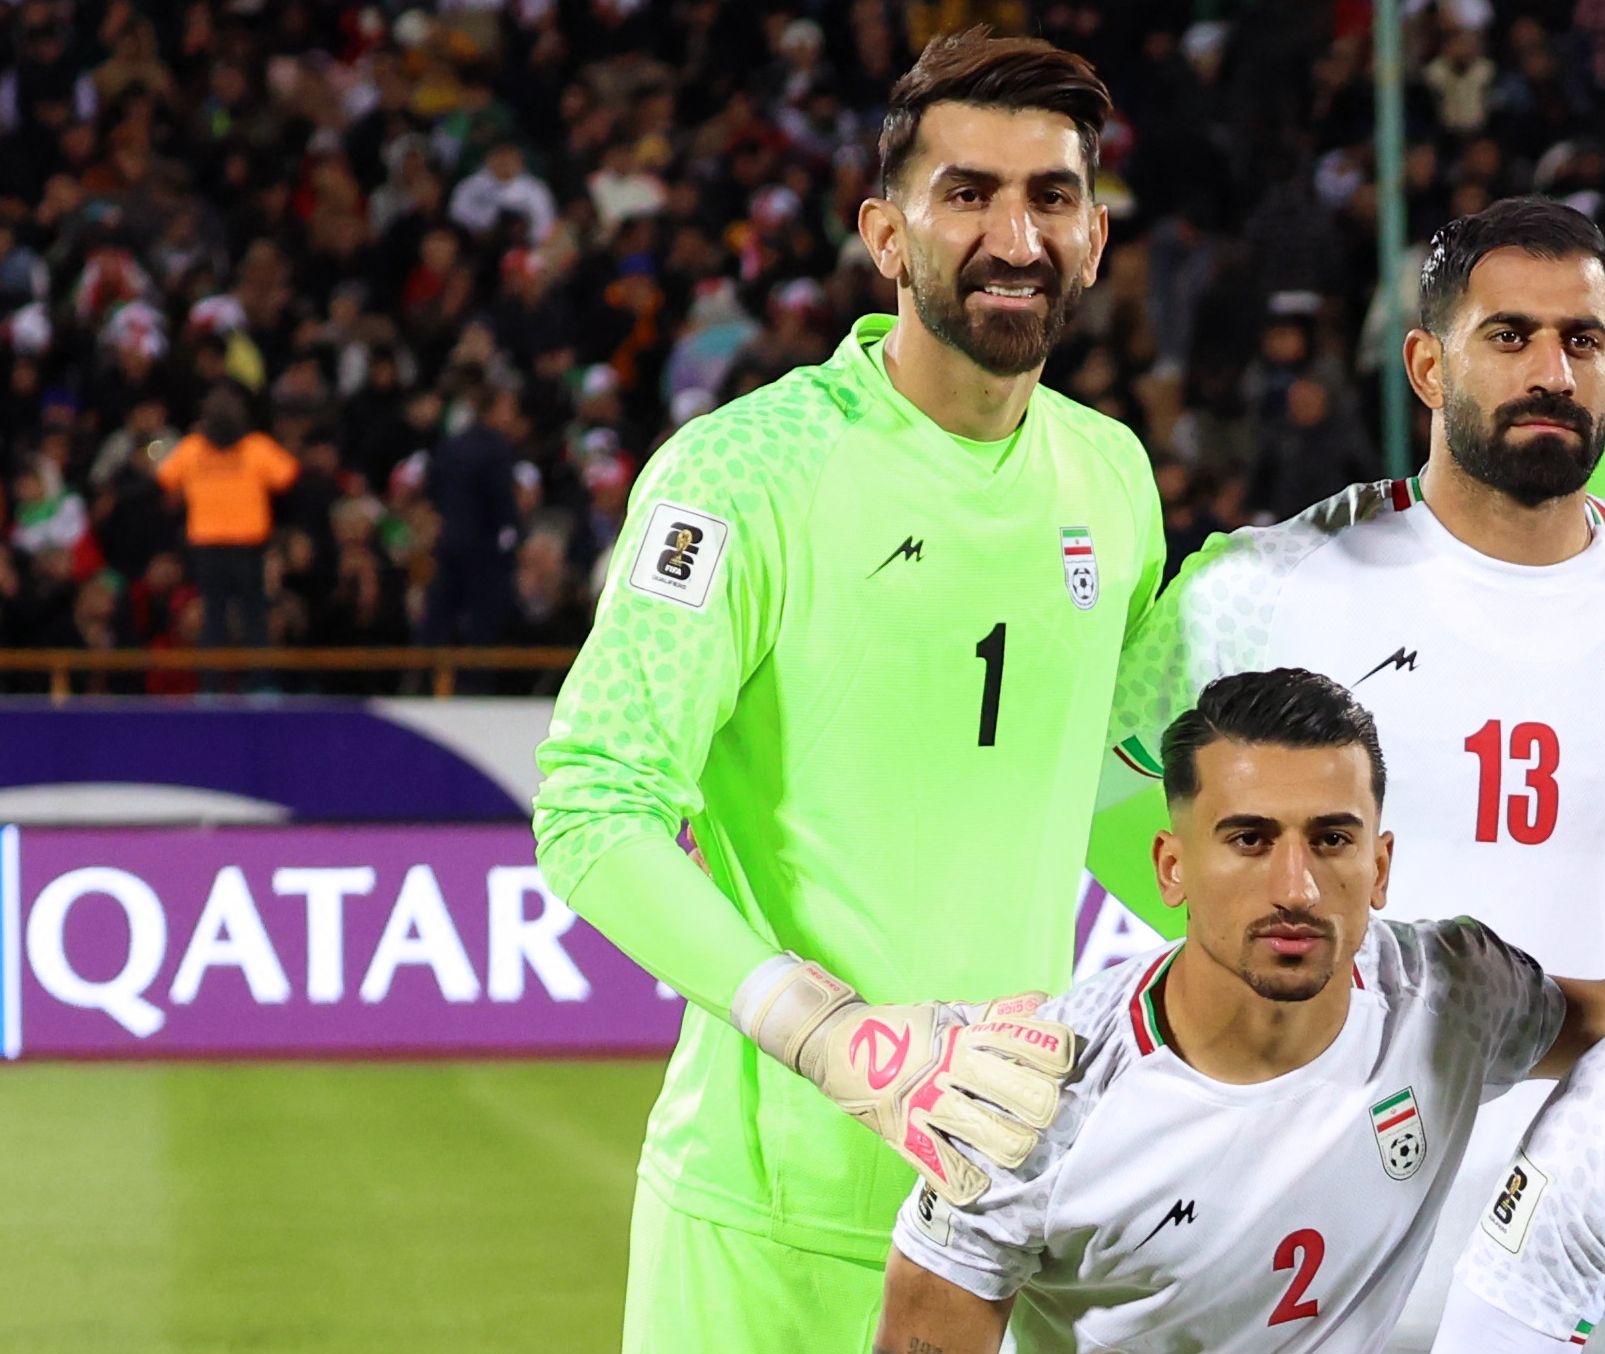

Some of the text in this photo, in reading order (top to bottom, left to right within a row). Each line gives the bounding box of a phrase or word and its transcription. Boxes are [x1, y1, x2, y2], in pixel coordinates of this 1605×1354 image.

[975, 622, 1007, 747] 1
[1464, 719, 1561, 845] 13
[26, 864, 591, 1038] QATAR
[971, 1020, 1060, 1053] RAPTOR
[1267, 1227, 1325, 1327] 2
